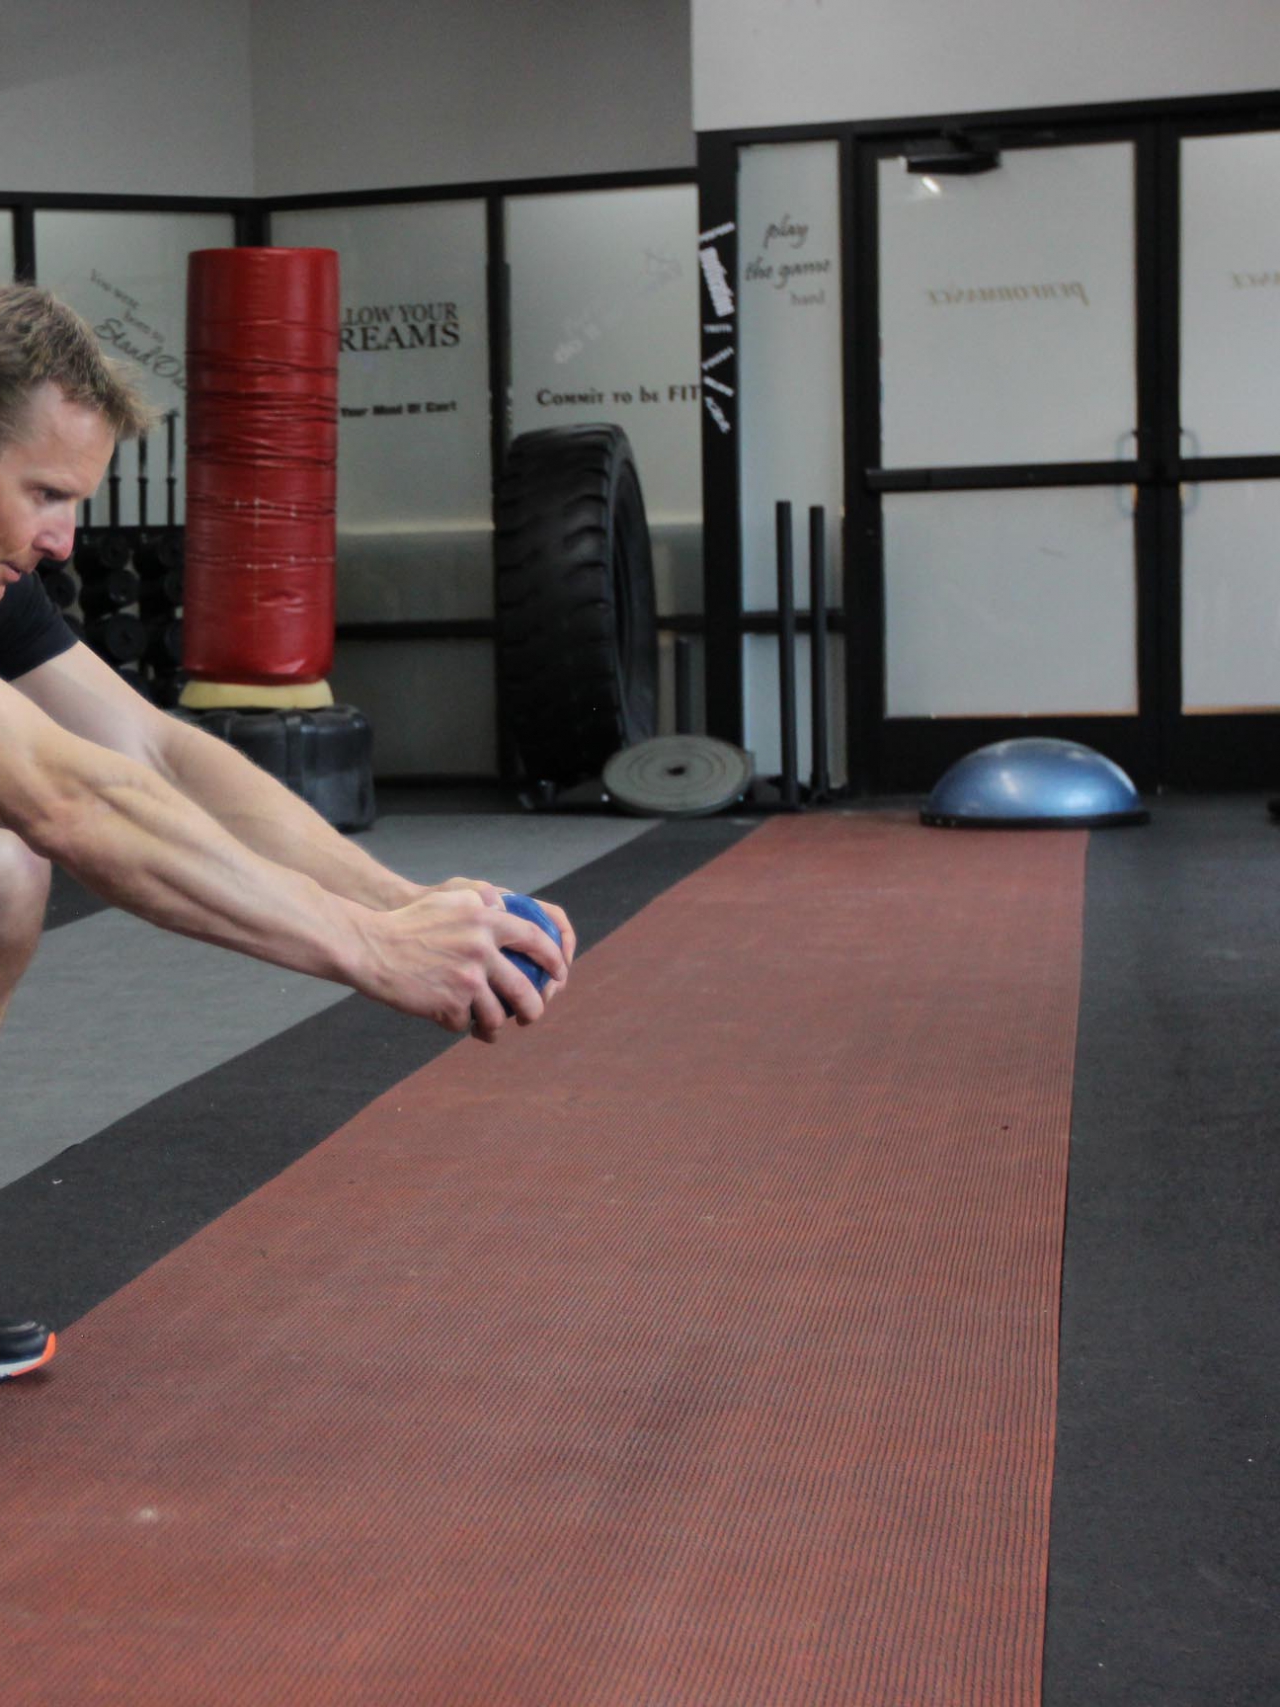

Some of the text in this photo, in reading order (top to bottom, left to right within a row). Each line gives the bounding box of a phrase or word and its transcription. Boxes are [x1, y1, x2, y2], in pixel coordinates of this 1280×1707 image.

[763, 212, 810, 249] play
[744, 255, 831, 290] the game
[399, 301, 459, 324] YOUR
[339, 322, 460, 352] REAMS
[668, 384, 701, 402] FIT
